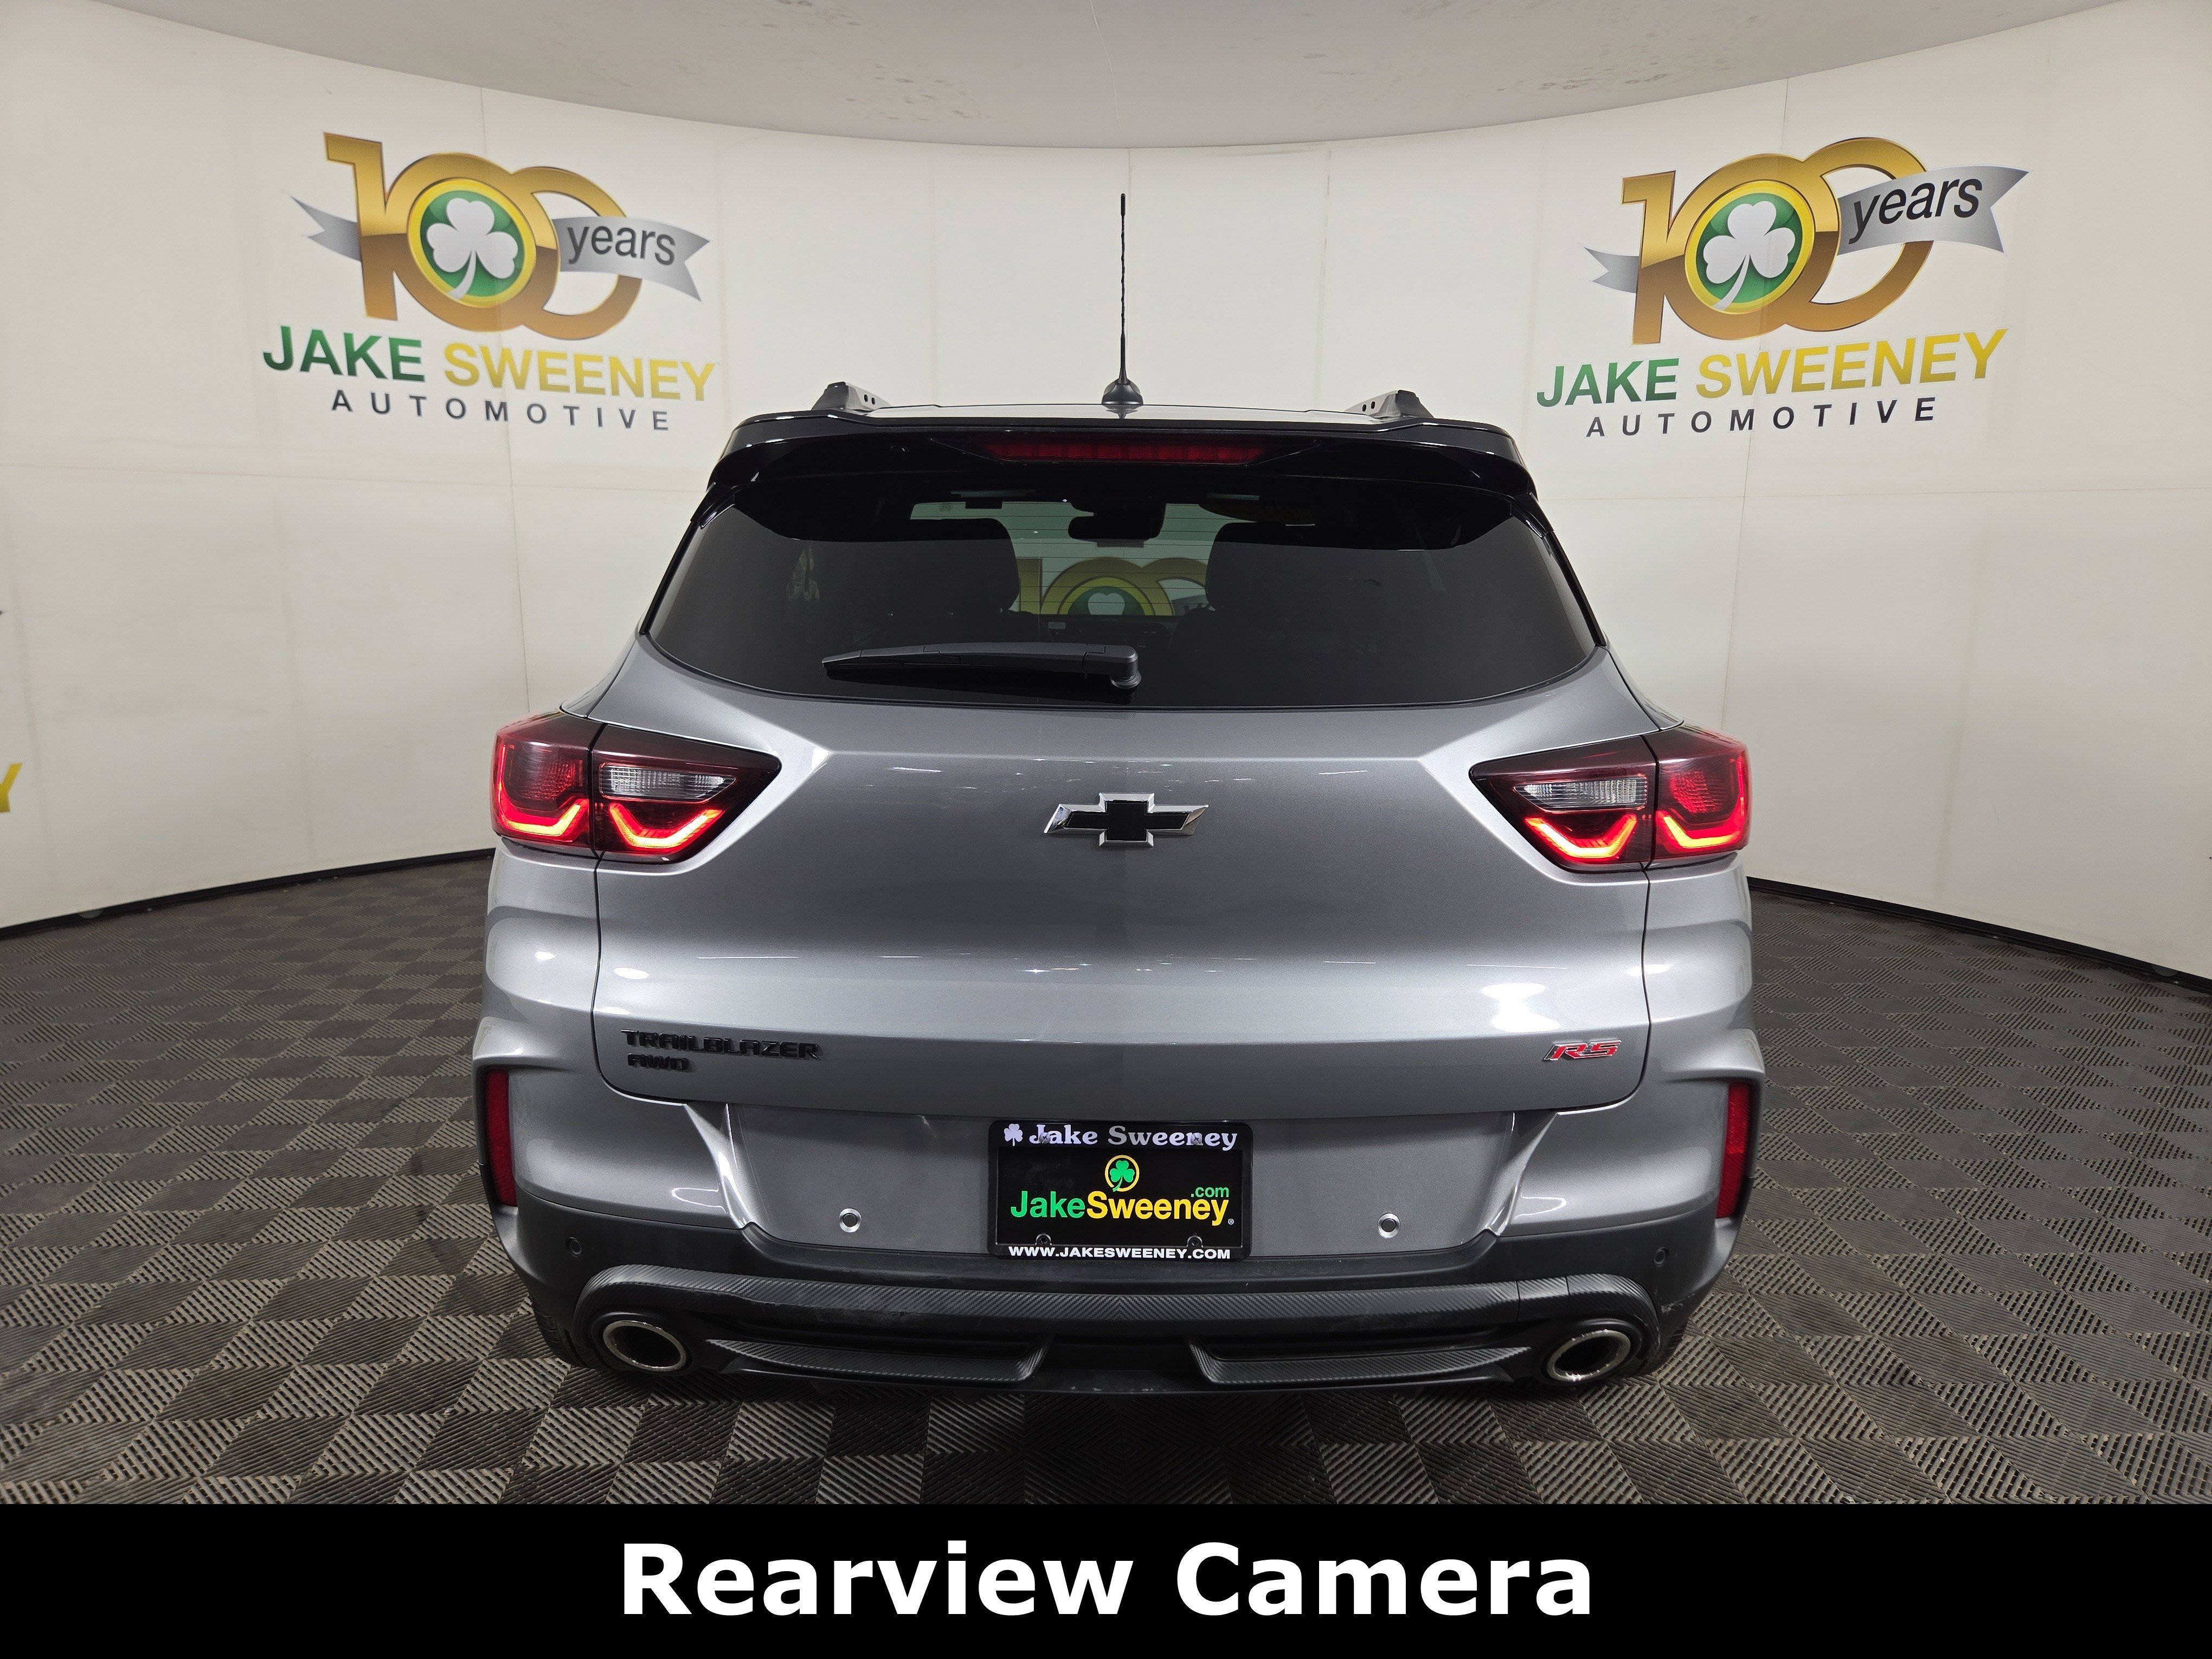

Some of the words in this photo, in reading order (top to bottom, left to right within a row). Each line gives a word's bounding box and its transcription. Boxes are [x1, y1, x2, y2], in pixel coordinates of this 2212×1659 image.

[324, 132, 642, 340] 100
[567, 225, 676, 266] years
[1621, 137, 1933, 345] 100
[1848, 178, 1983, 245] years
[263, 325, 426, 383] JAKE
[444, 343, 716, 402] SWEENEY
[1536, 358, 1679, 408] JAKE
[1695, 329, 2009, 399] SWEENEY
[331, 389, 669, 431] AUTOMOTIVE
[1586, 396, 1936, 438] AUTOMOTIVE
[621, 1029, 820, 1059] TRAILBLAZER
[1544, 1040, 1622, 1060] RS
[627, 1053, 690, 1071] AWD
[1029, 1124, 1098, 1145] Jake
[1108, 1126, 1238, 1151] Sweeney
[1011, 1191, 1229, 1226] JakeSweeney
[1191, 1187, 1230, 1198] .com
[1008, 1246, 1231, 1259] WWW.JAKESWEENEY.COM
